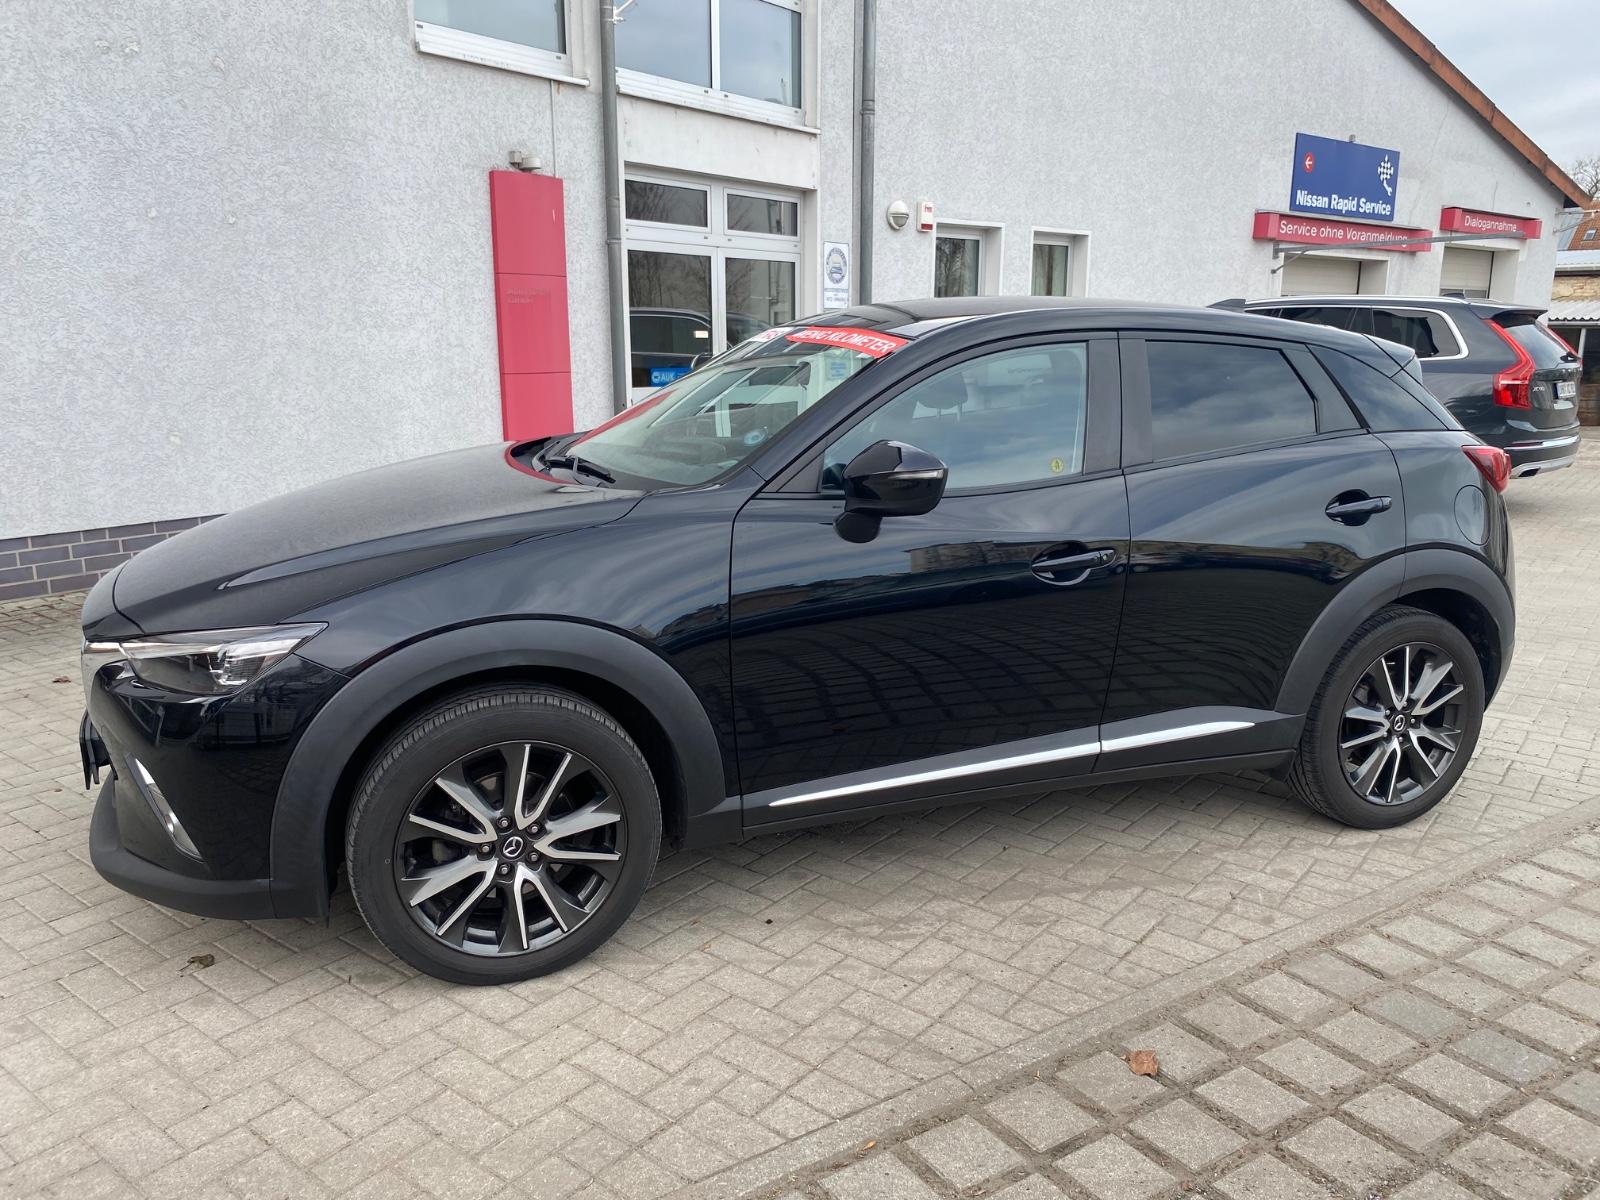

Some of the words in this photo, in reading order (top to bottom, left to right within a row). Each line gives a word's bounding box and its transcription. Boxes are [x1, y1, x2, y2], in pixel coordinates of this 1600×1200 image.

[1295, 189, 1328, 209] Nissan
[1331, 194, 1357, 214] Rapid
[1359, 198, 1391, 216] Service
[1279, 220, 1317, 236] Service
[1320, 226, 1344, 239] ohne
[1464, 215, 1517, 232] Dialogannahme
[824, 331, 897, 353] KILOMETER
